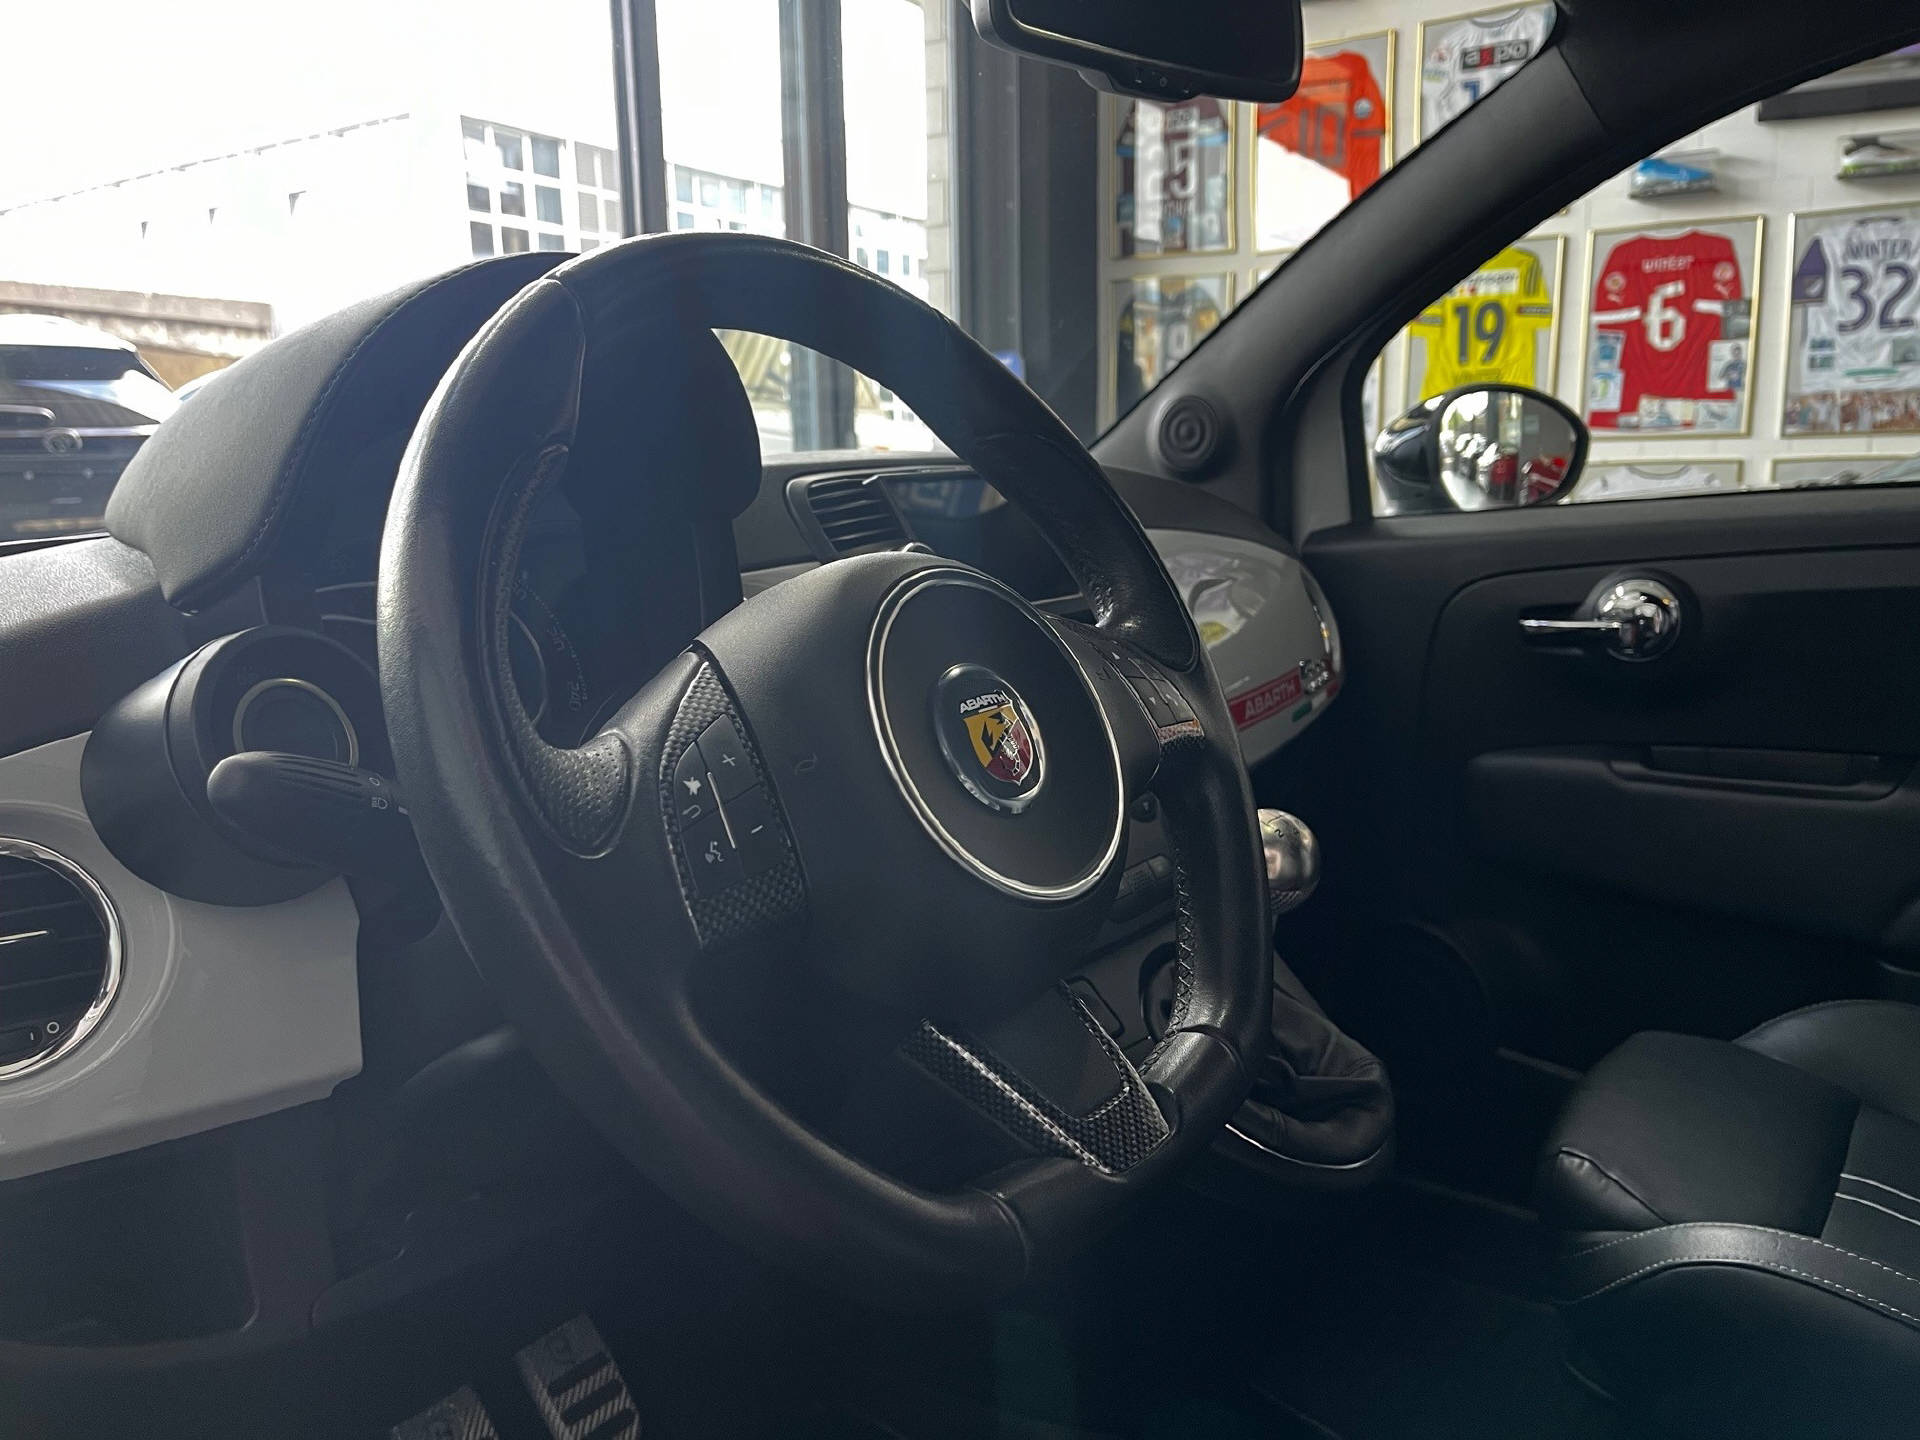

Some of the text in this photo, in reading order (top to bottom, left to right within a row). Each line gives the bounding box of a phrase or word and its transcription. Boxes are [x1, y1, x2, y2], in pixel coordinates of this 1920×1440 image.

[1644, 280, 1686, 351] 6
[1837, 264, 1915, 331] 32
[1454, 301, 1506, 365] 19
[959, 693, 1007, 714] ABARTH
[1245, 680, 1295, 719] ABARTH
